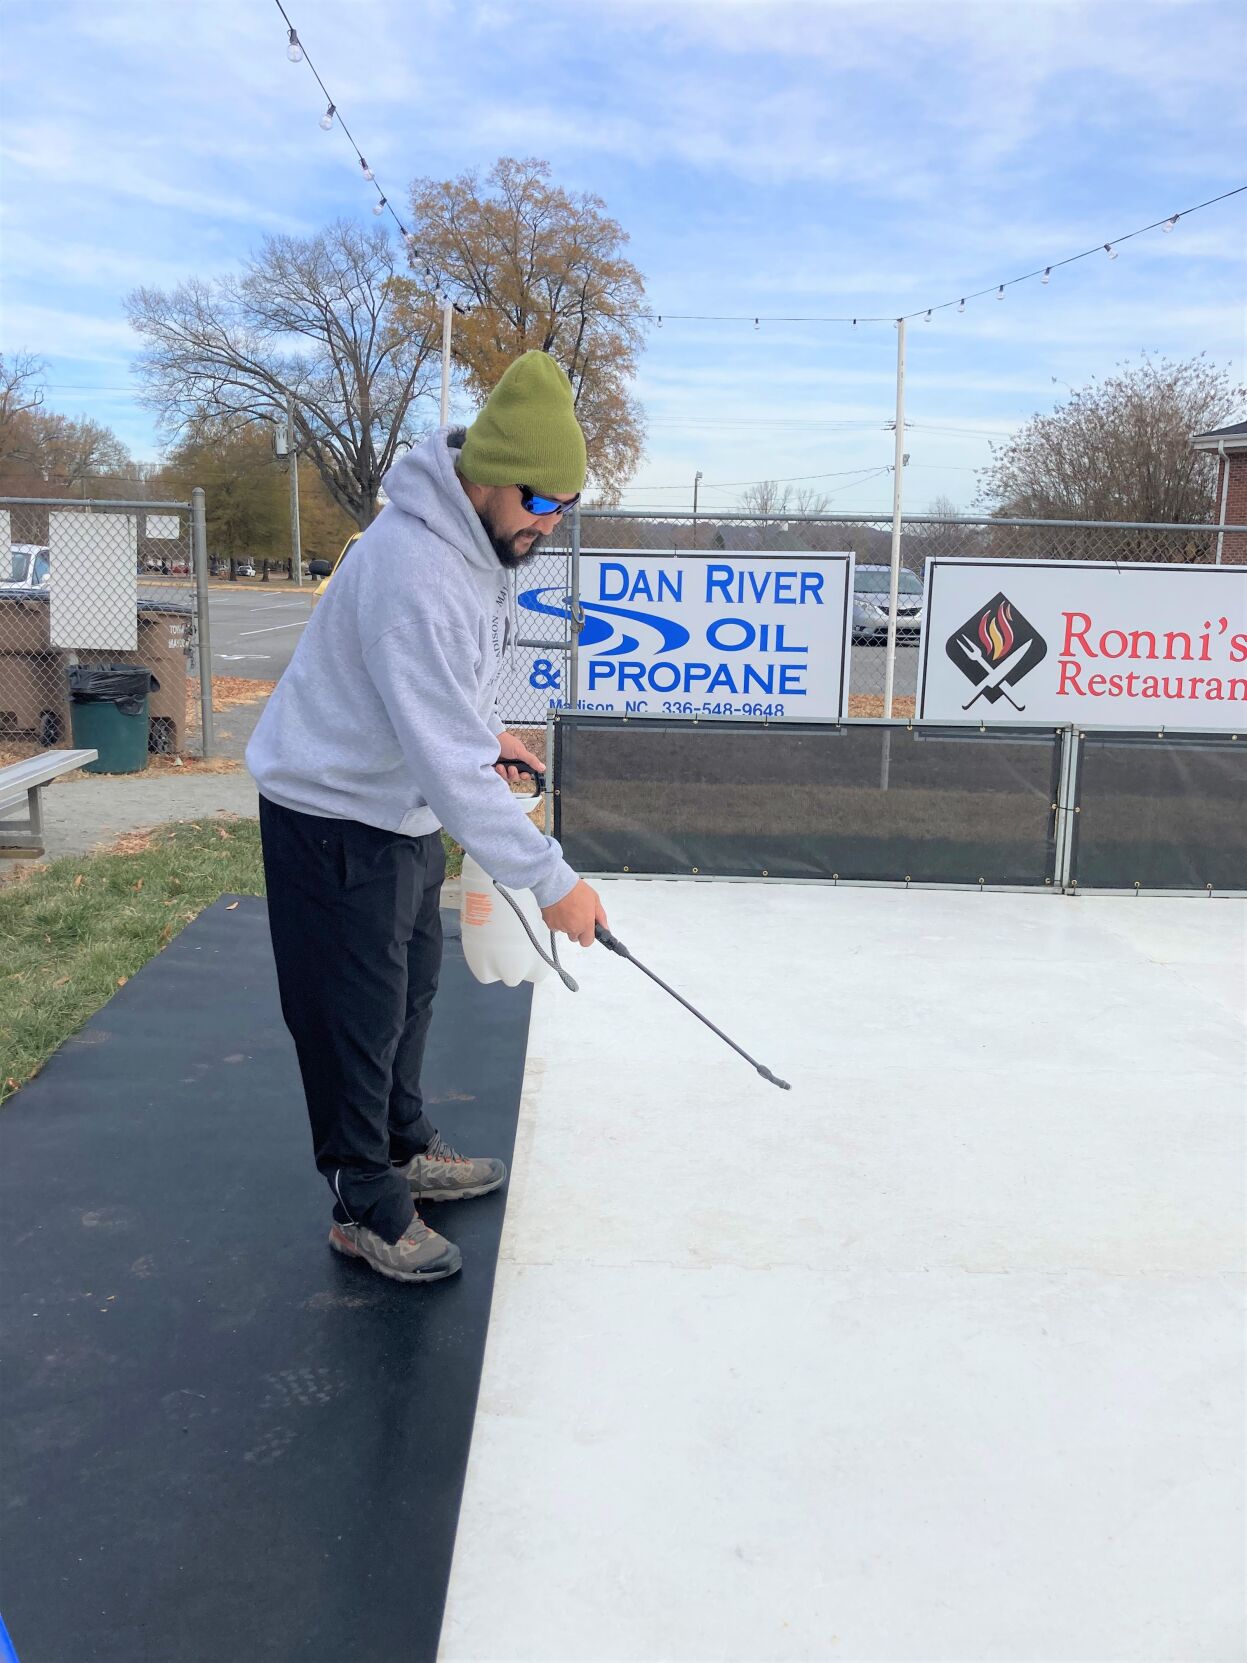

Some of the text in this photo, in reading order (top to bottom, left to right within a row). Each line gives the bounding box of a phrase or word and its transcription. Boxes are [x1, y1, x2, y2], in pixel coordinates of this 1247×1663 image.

[600, 563, 824, 604] DAN RIVER
[706, 618, 808, 653] OIL
[1058, 612, 1247, 662] Ronni's
[529, 659, 560, 689] &
[588, 661, 807, 695] PROPANE
[662, 701, 784, 716] 336-548-9648
